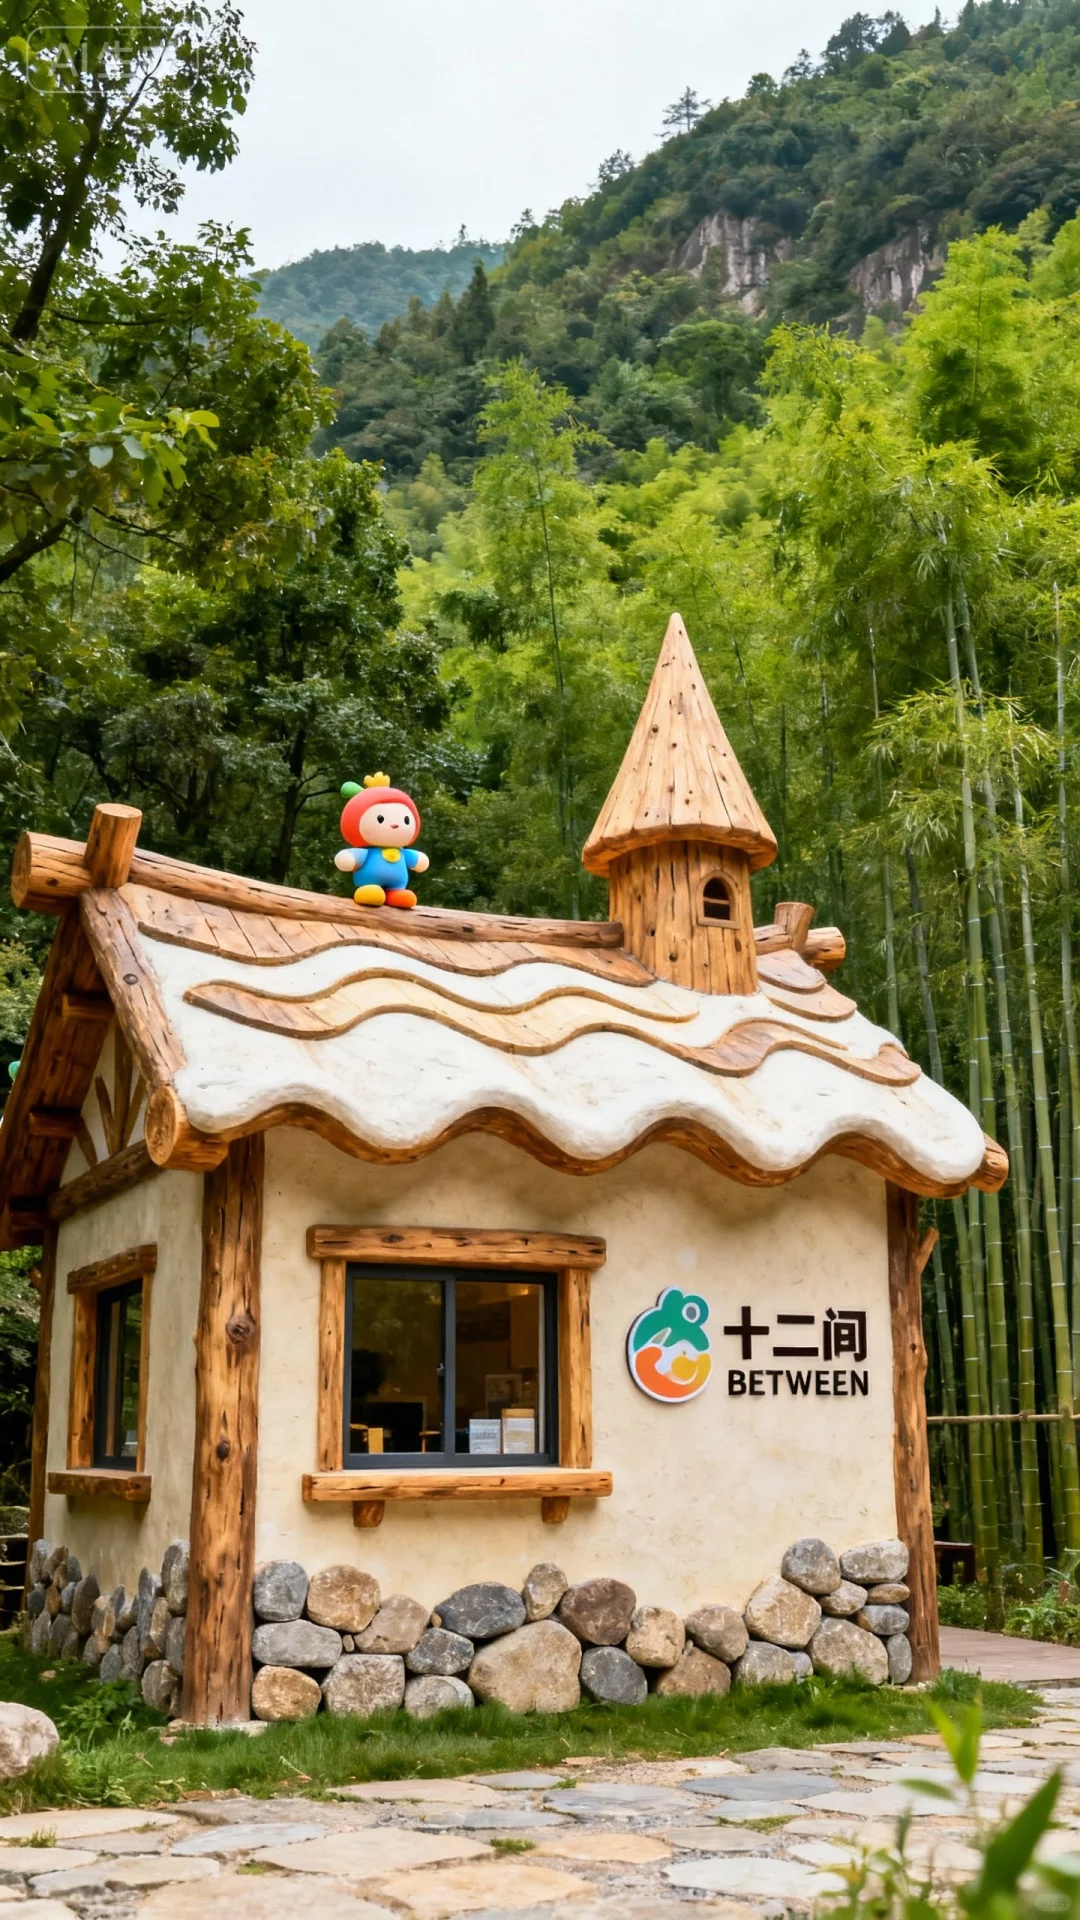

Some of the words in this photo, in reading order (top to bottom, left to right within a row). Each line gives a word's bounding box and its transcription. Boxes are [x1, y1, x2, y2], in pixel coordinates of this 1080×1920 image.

[723, 1305, 867, 1362] 十二间
[728, 1370, 868, 1396] BETWEEN
